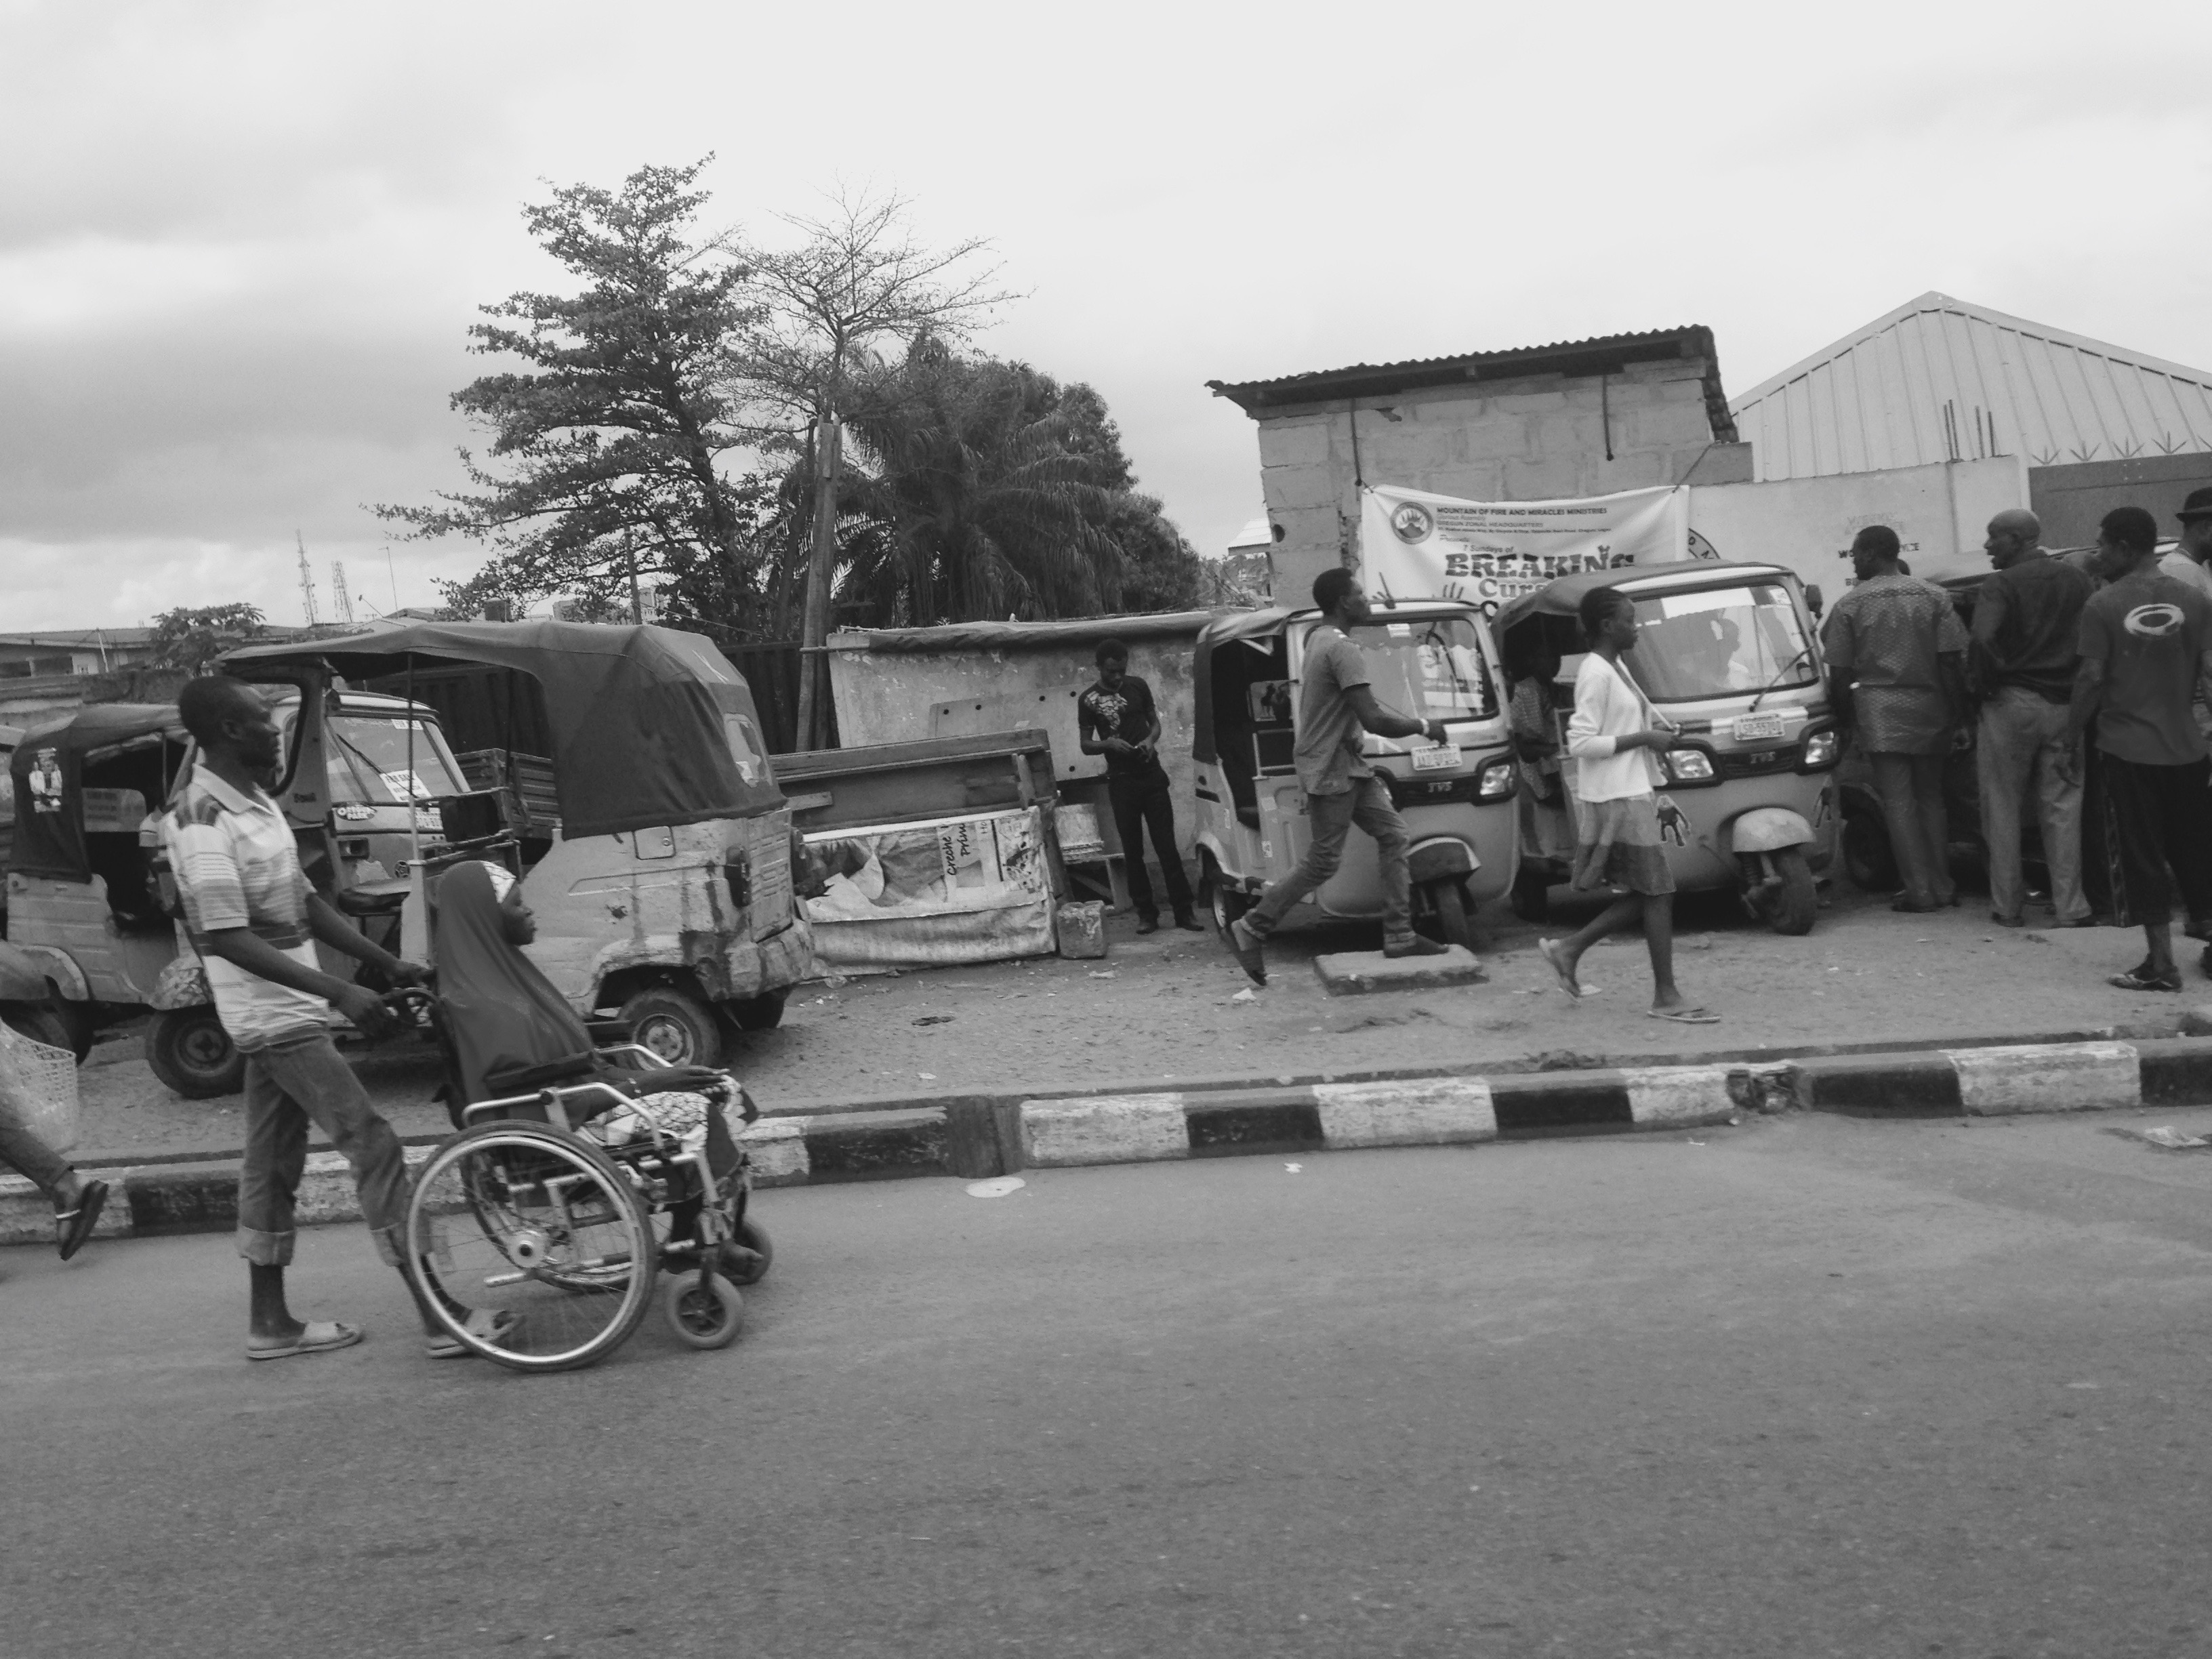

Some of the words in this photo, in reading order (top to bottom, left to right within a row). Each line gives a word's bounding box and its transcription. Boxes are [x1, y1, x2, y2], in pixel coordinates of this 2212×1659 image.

[1566, 507, 1607, 515] MINISTRIES
[1750, 750, 1776, 764] TVS
[1427, 781, 1453, 793] TVS
